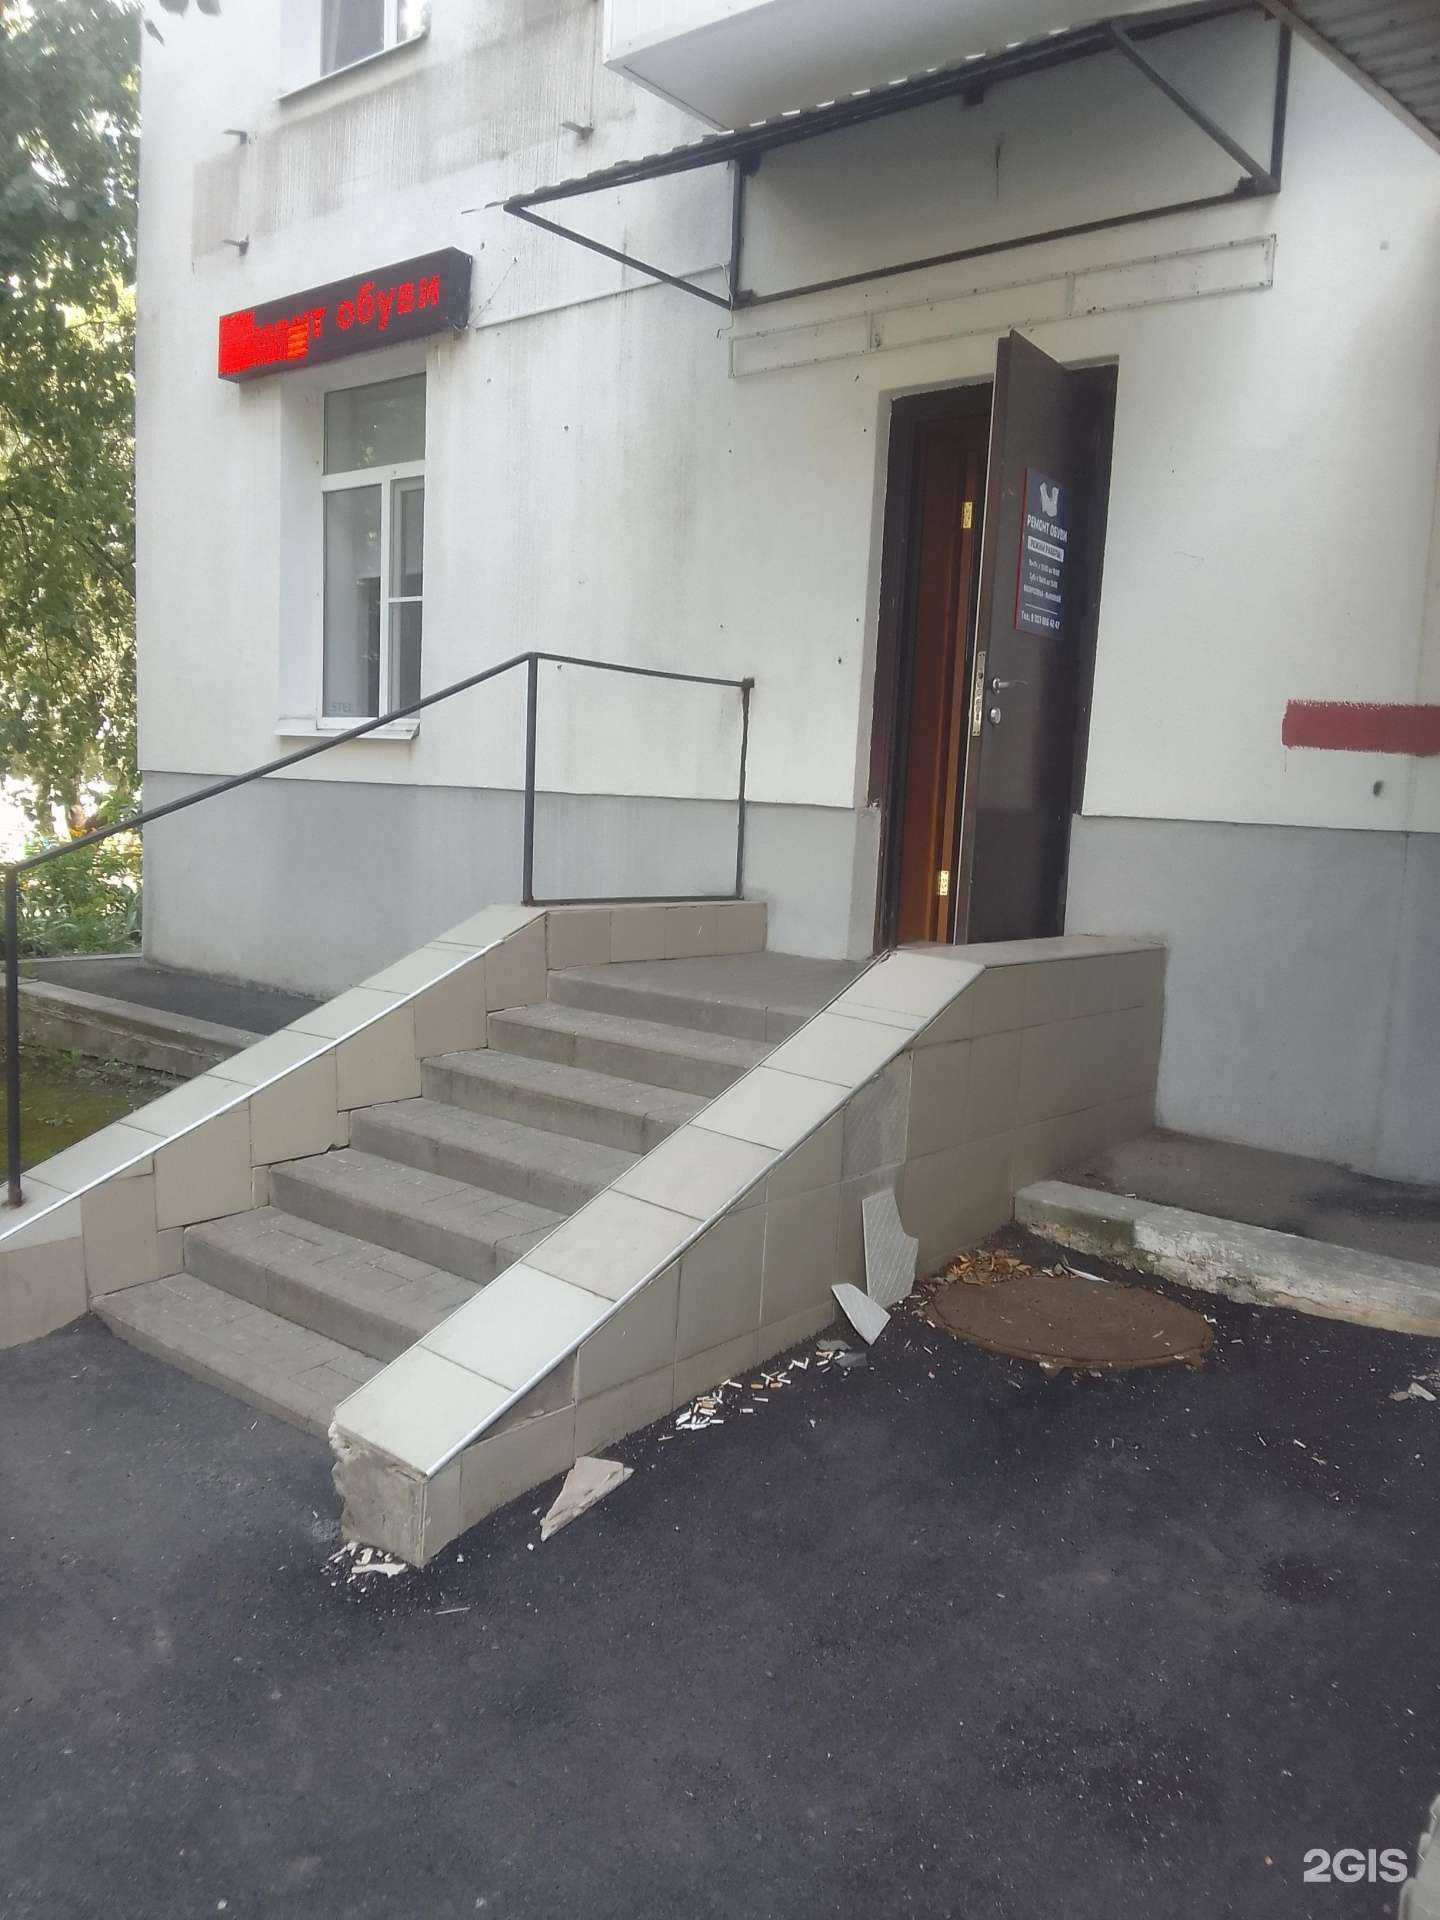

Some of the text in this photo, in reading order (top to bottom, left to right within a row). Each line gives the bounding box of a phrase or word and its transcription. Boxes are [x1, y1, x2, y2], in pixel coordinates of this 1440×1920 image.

[335, 273, 441, 331] обуви
[1026, 513, 1068, 544] РЕМОНТ ОБУВИ
